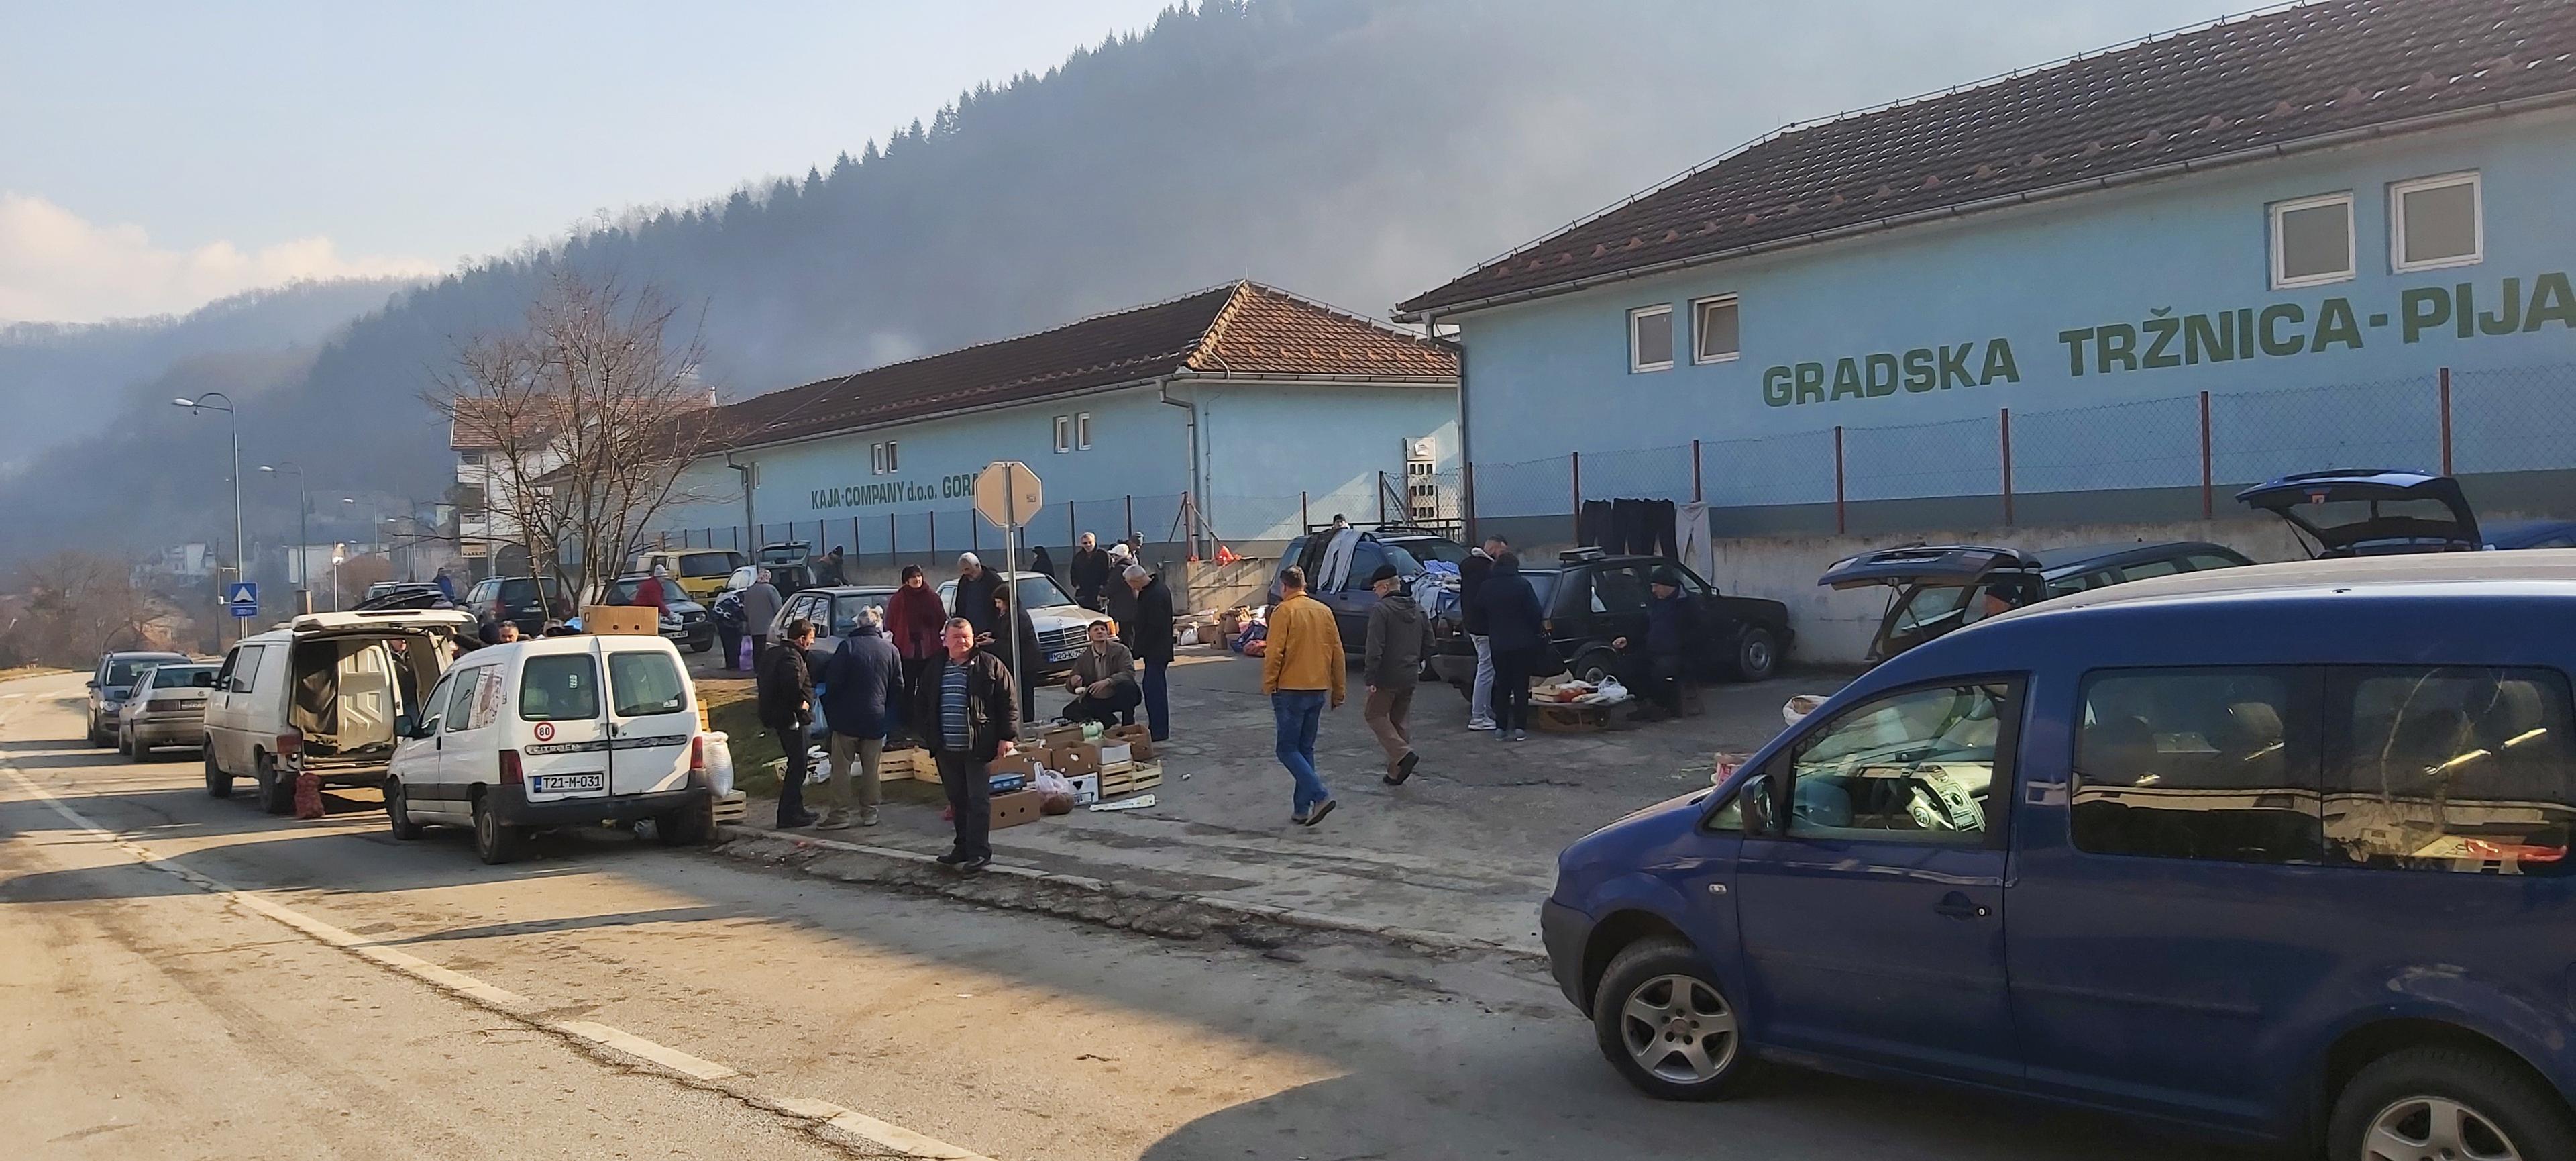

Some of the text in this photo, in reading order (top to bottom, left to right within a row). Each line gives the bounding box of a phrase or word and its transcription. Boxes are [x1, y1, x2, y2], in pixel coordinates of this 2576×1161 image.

[1762, 338, 2021, 407] GRADSKA
[907, 481, 938, 502] d.o.o.
[943, 468, 983, 499] GORA
[539, 727, 551, 736] 80
[543, 776, 601, 789] T21-M-031
